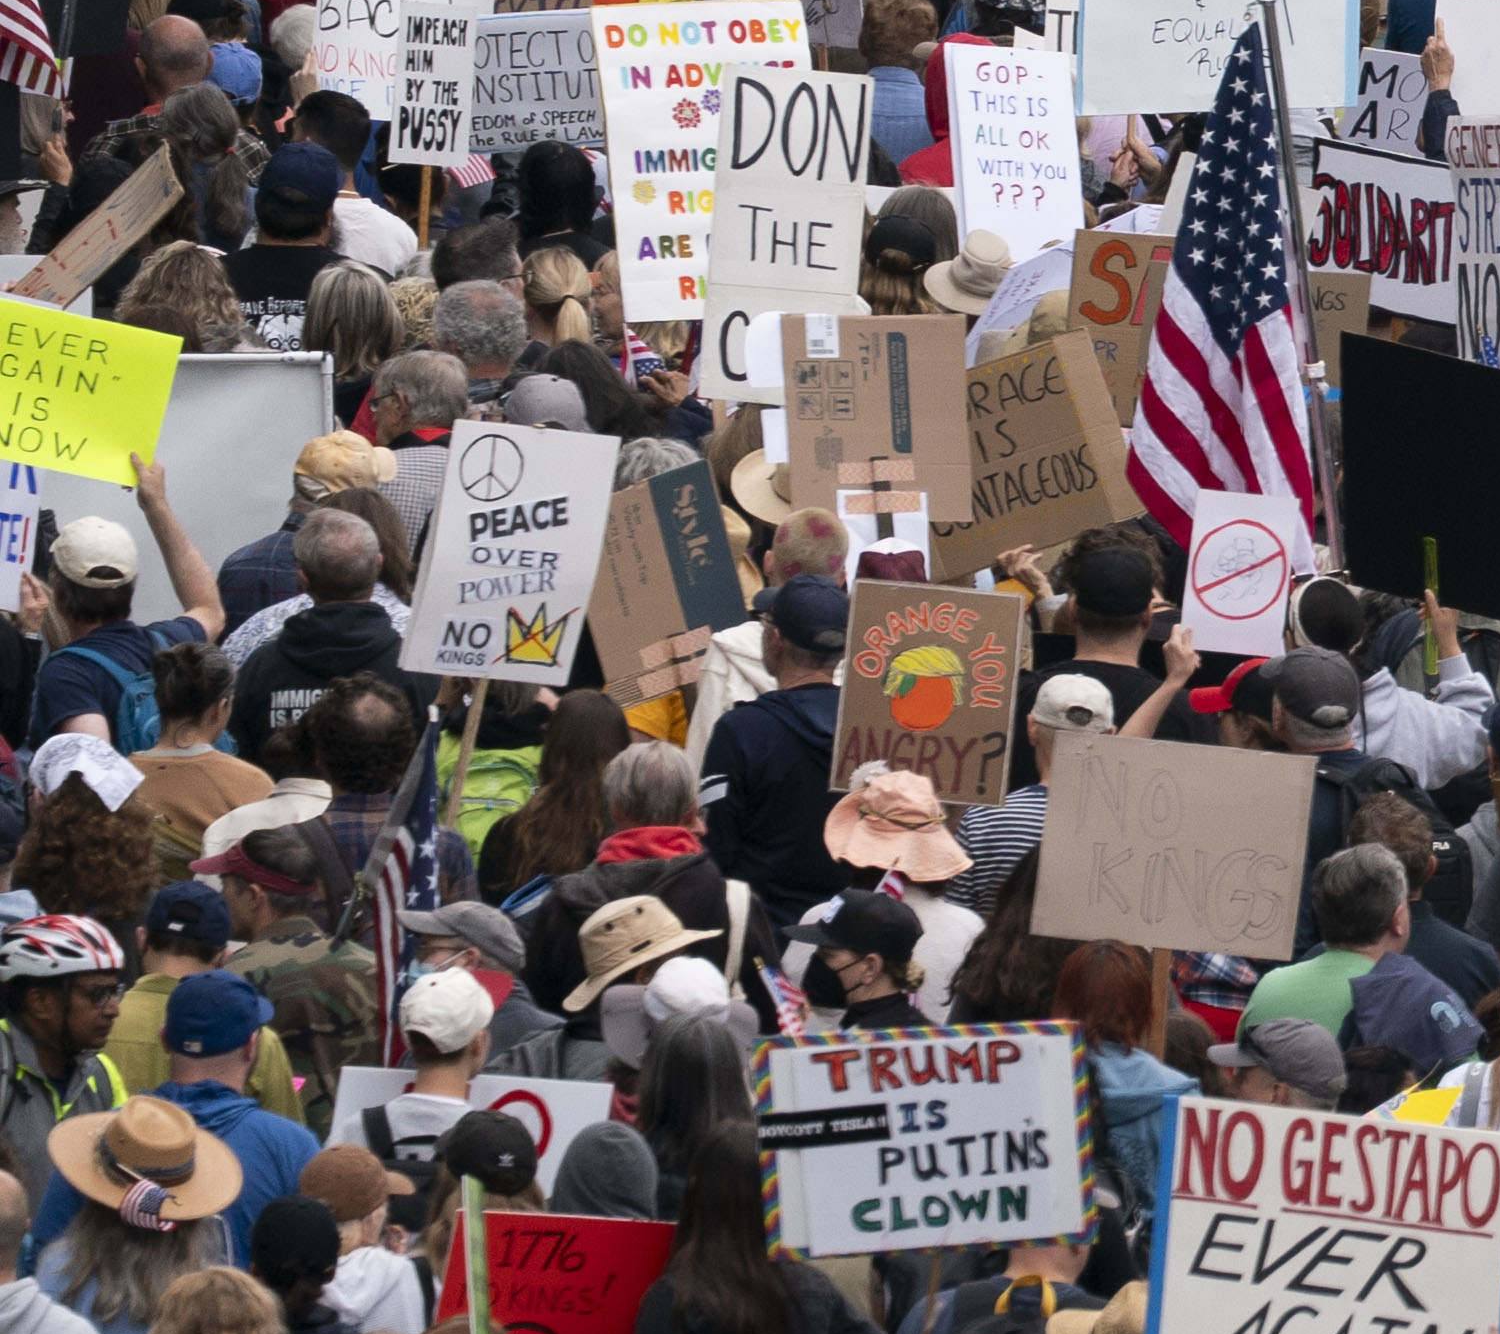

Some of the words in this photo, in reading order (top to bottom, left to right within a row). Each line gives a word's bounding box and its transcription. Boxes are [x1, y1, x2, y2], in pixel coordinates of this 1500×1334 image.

[730, 83, 866, 184] DON
[469, 496, 571, 544] PEACE
[457, 571, 556, 605] POWER
[810, 1040, 1022, 1093] TRUMP
[758, 1122, 825, 1138] BOYCOTT
[897, 1099, 948, 1133] IS
[1179, 1111, 1264, 1200] NO
[851, 1185, 1030, 1233] CLOWN
